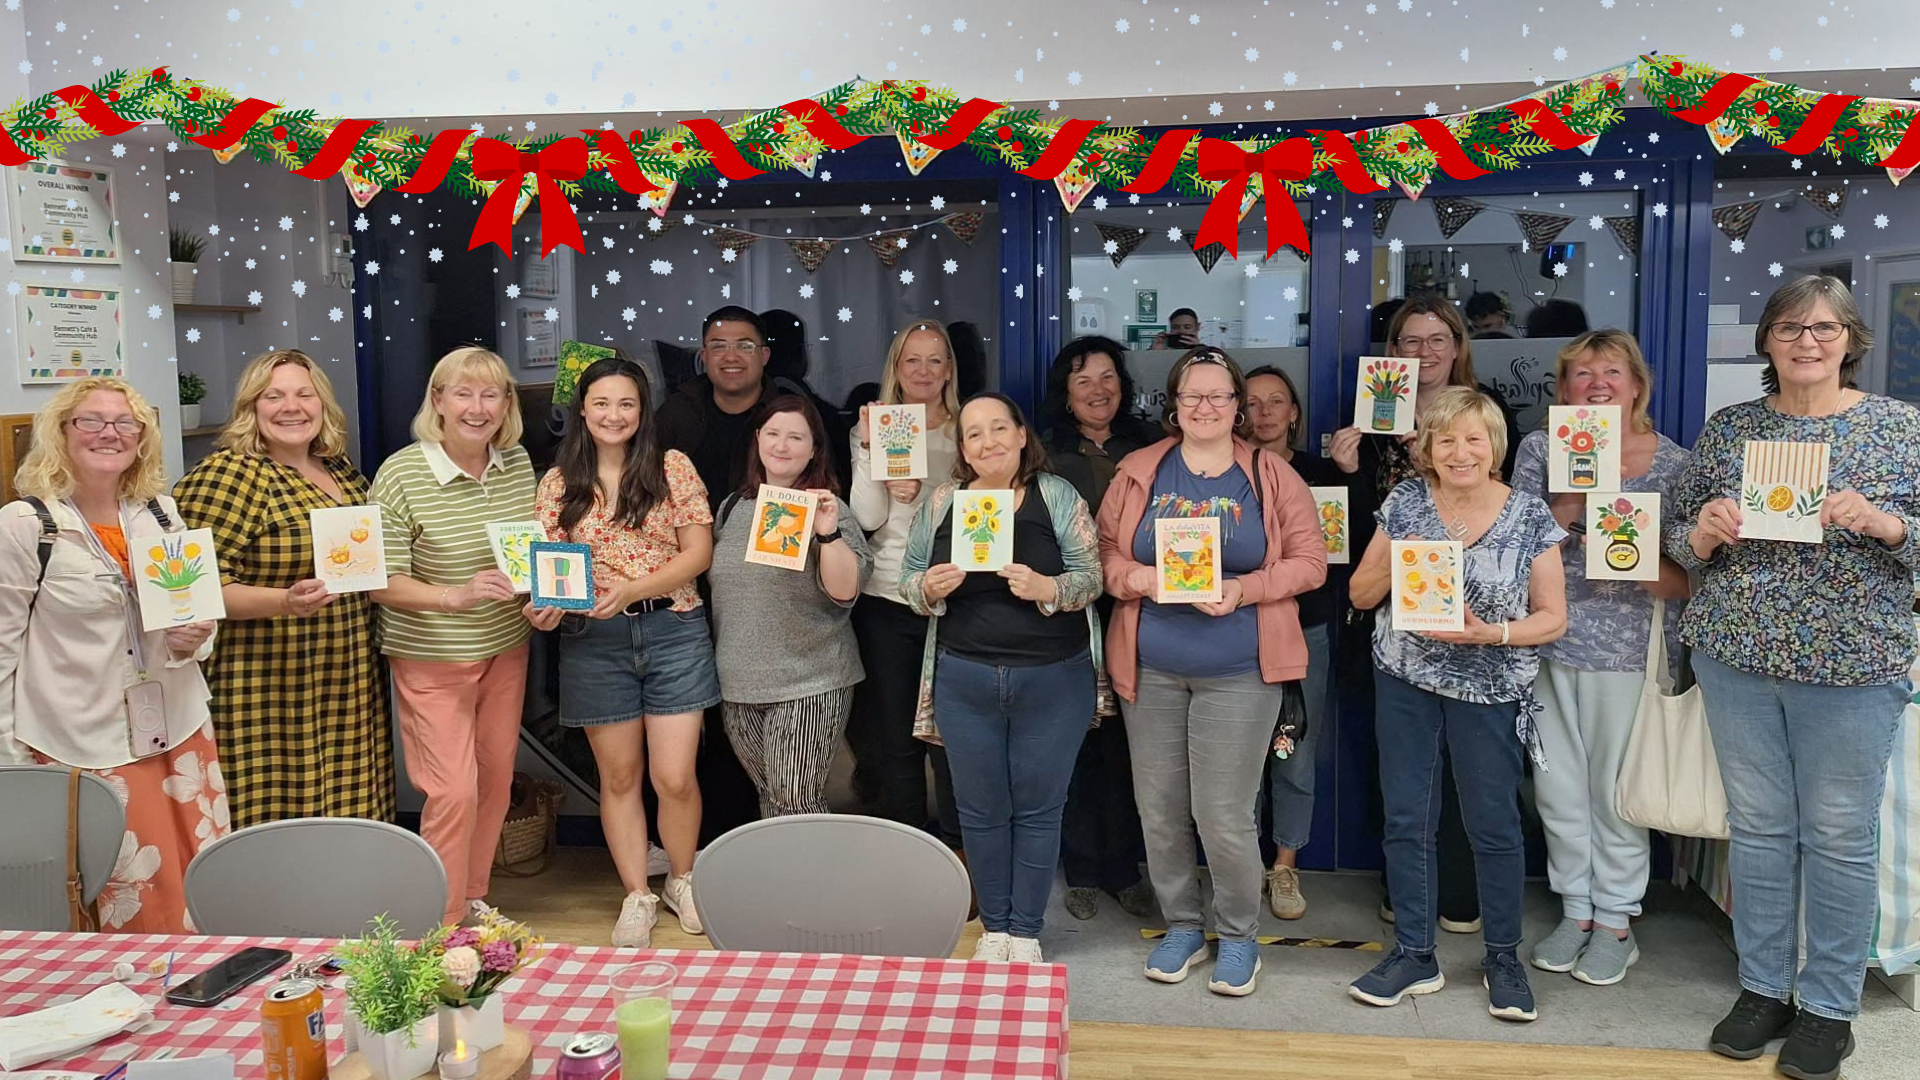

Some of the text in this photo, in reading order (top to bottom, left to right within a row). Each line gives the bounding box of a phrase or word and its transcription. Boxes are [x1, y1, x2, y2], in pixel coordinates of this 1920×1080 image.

[37, 180, 89, 192] OVERALL WINNER
[44, 210, 76, 219] Community
[50, 302, 77, 310] CATEGORY
[54, 331, 85, 340] Community
[766, 489, 810, 505] IL DOLCE
